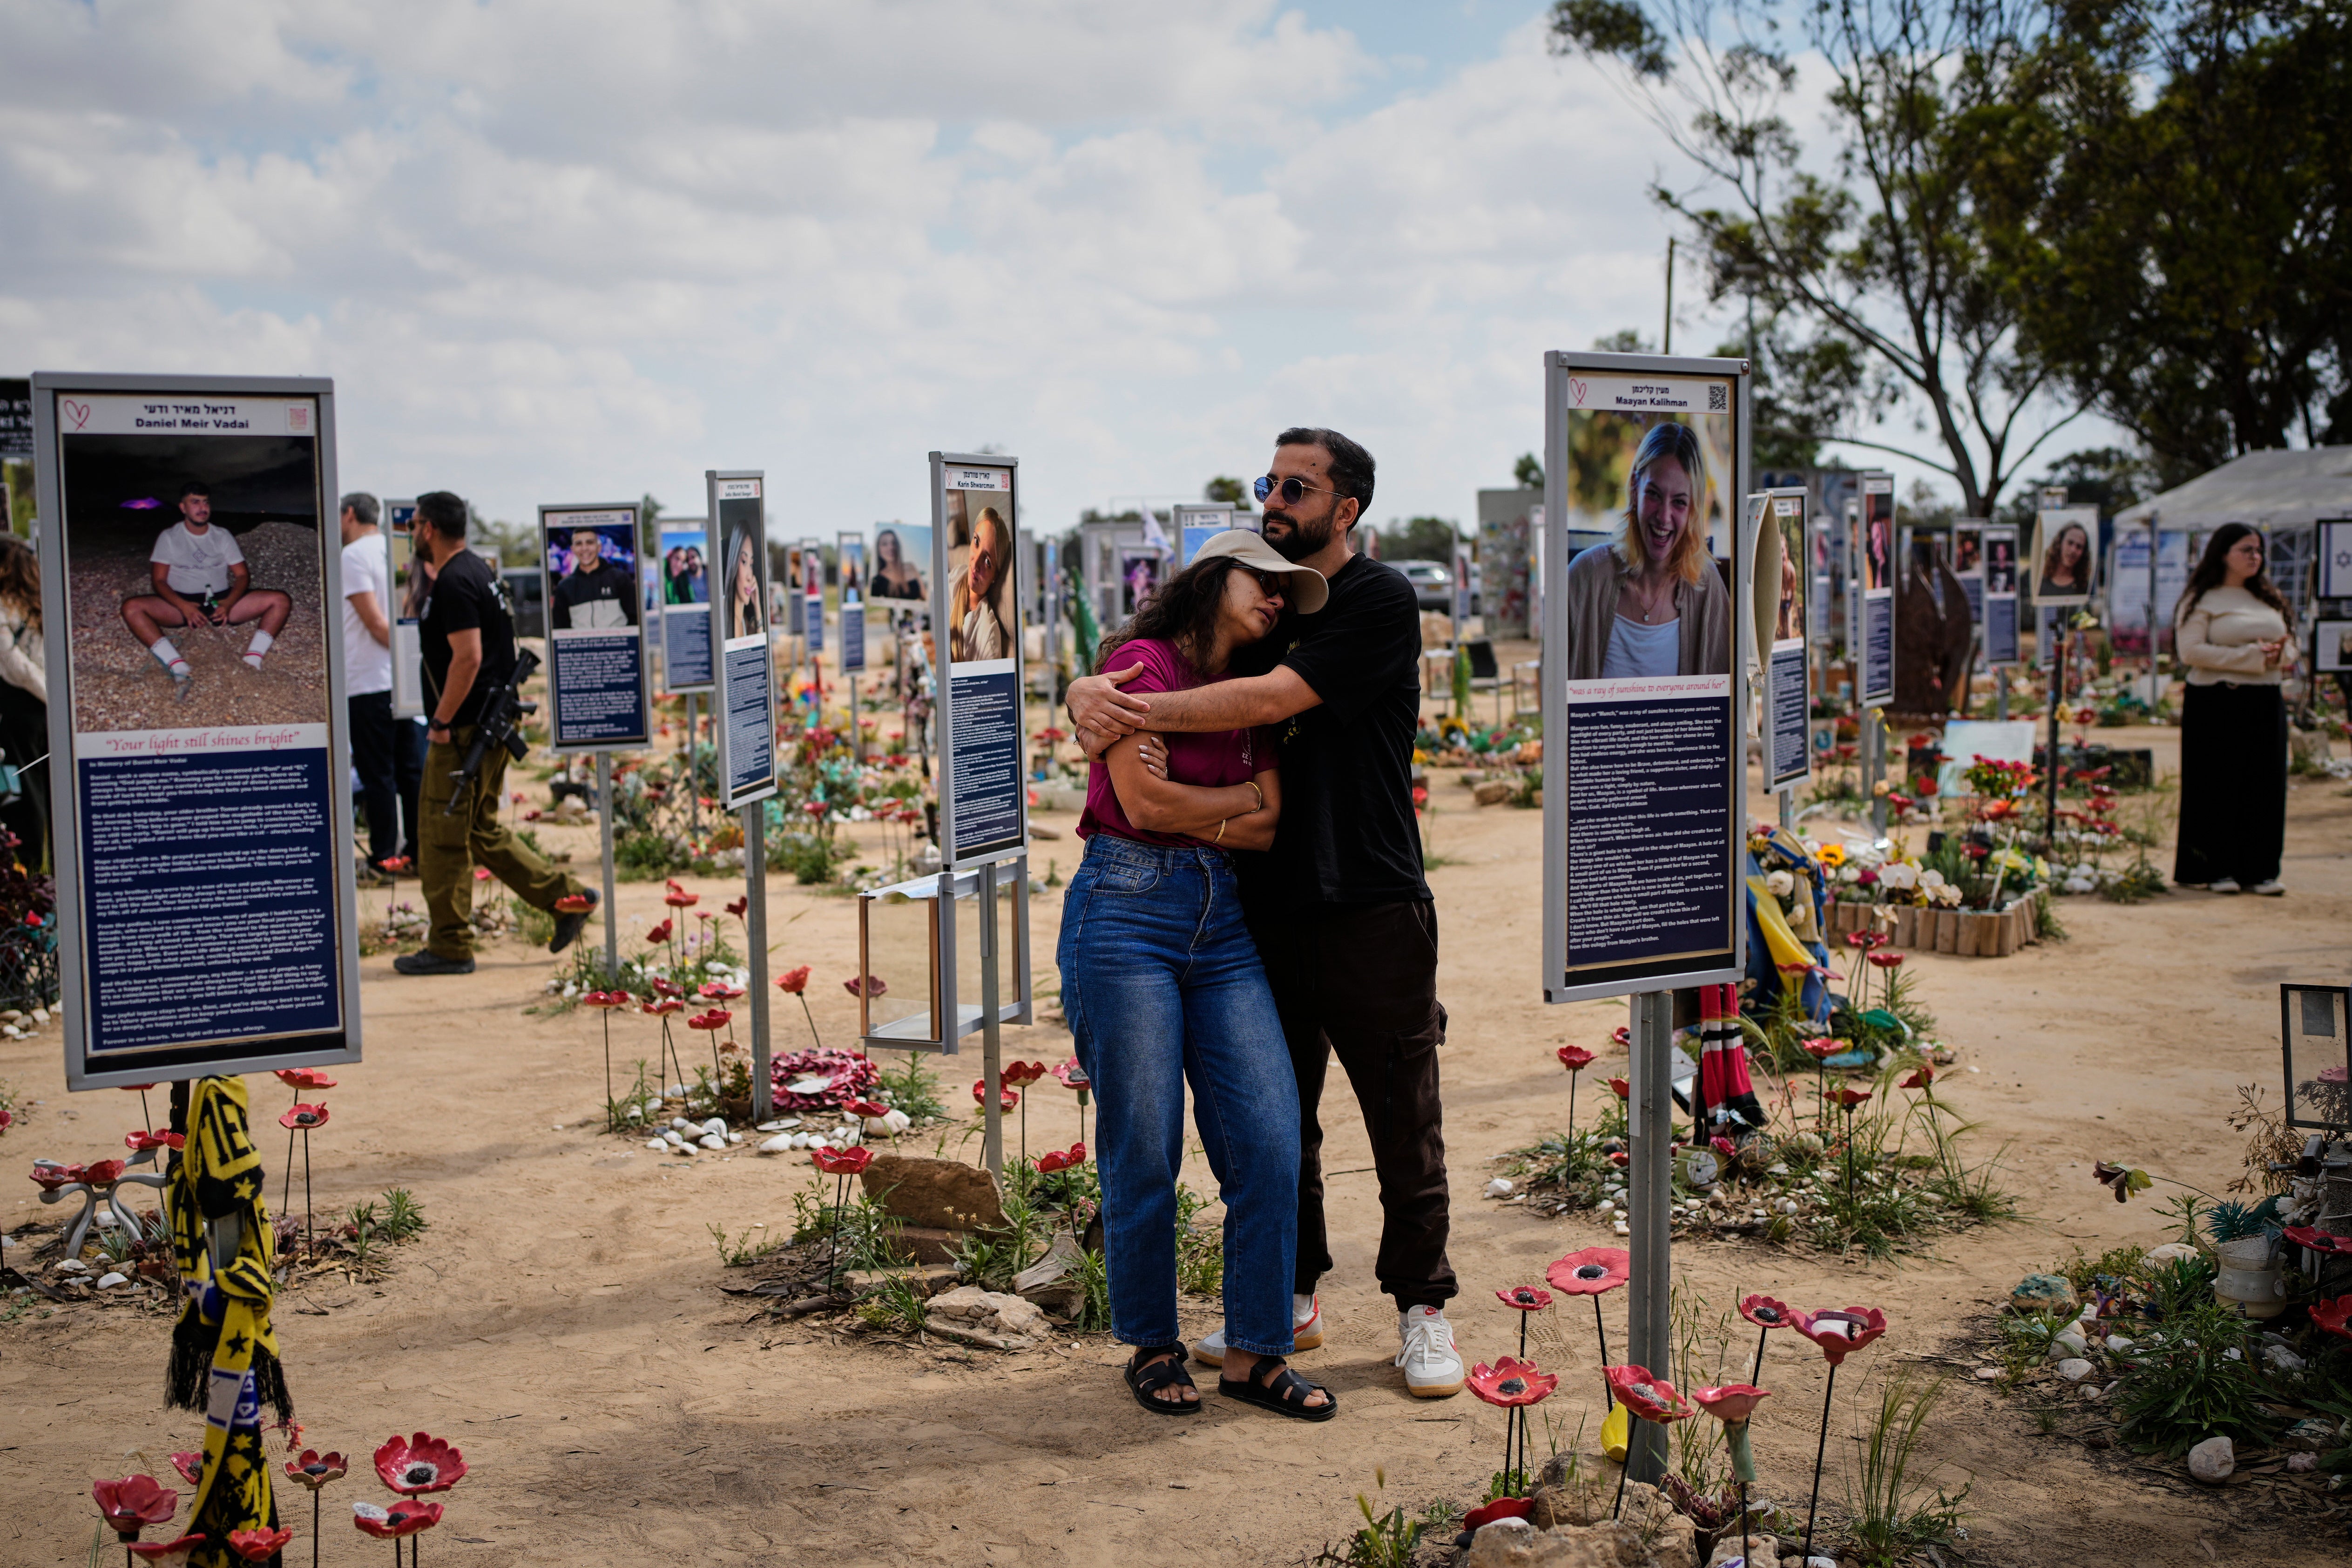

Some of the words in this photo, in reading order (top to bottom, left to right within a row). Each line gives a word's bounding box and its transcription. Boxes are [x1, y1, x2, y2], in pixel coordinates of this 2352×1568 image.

[1616, 397, 1647, 407] Maayan
[1650, 398, 1687, 406] Kalihman
[144, 405, 168, 414] ודעי
[173, 405, 200, 414] מאיר
[204, 404, 236, 415] דניאל
[135, 419, 176, 428] Daniel
[182, 419, 209, 428] Meir
[213, 419, 249, 429] Vadai
[1594, 688, 1606, 698] ray
[1608, 683, 1616, 698] of
[1616, 682, 1646, 694] sunshine
[1656, 685, 1684, 695] everyone
[1686, 679, 1711, 690] around
[149, 733, 179, 756] light
[184, 732, 211, 748] still
[211, 731, 250, 747] shines
